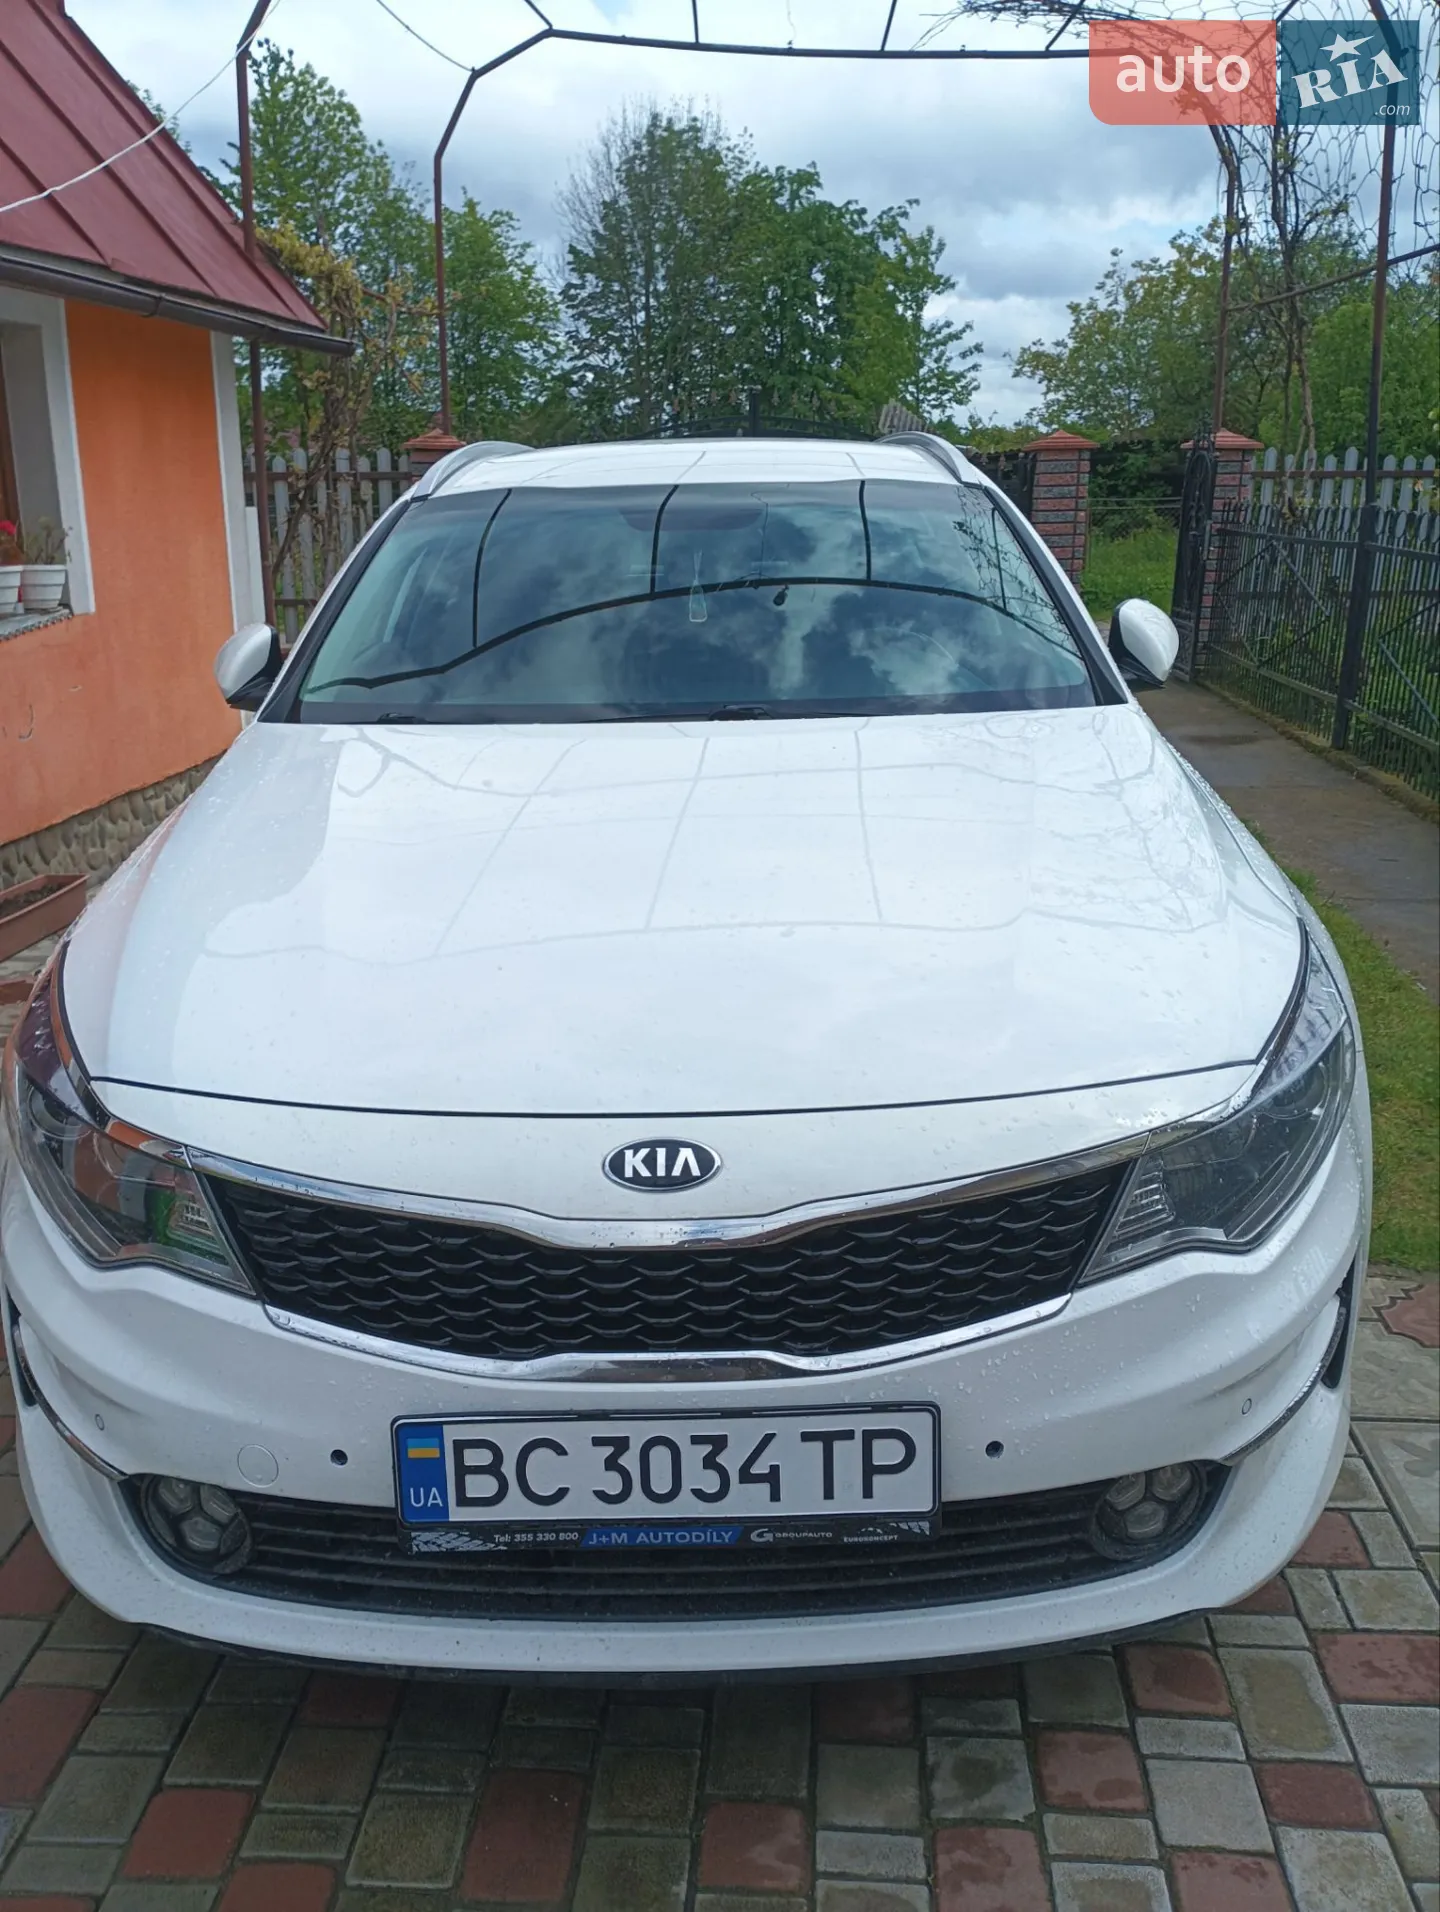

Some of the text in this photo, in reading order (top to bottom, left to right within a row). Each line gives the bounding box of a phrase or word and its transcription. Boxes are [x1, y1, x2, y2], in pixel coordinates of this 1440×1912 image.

[623, 1147, 701, 1178] KIA
[452, 1428, 917, 1508] BC 3034 TP
[409, 1487, 443, 1508] UA
[493, 1534, 512, 1543] Tel:
[514, 1533, 533, 1542] 355
[536, 1532, 556, 1541] 330
[589, 1529, 733, 1545] J+M AUTODÍLY
